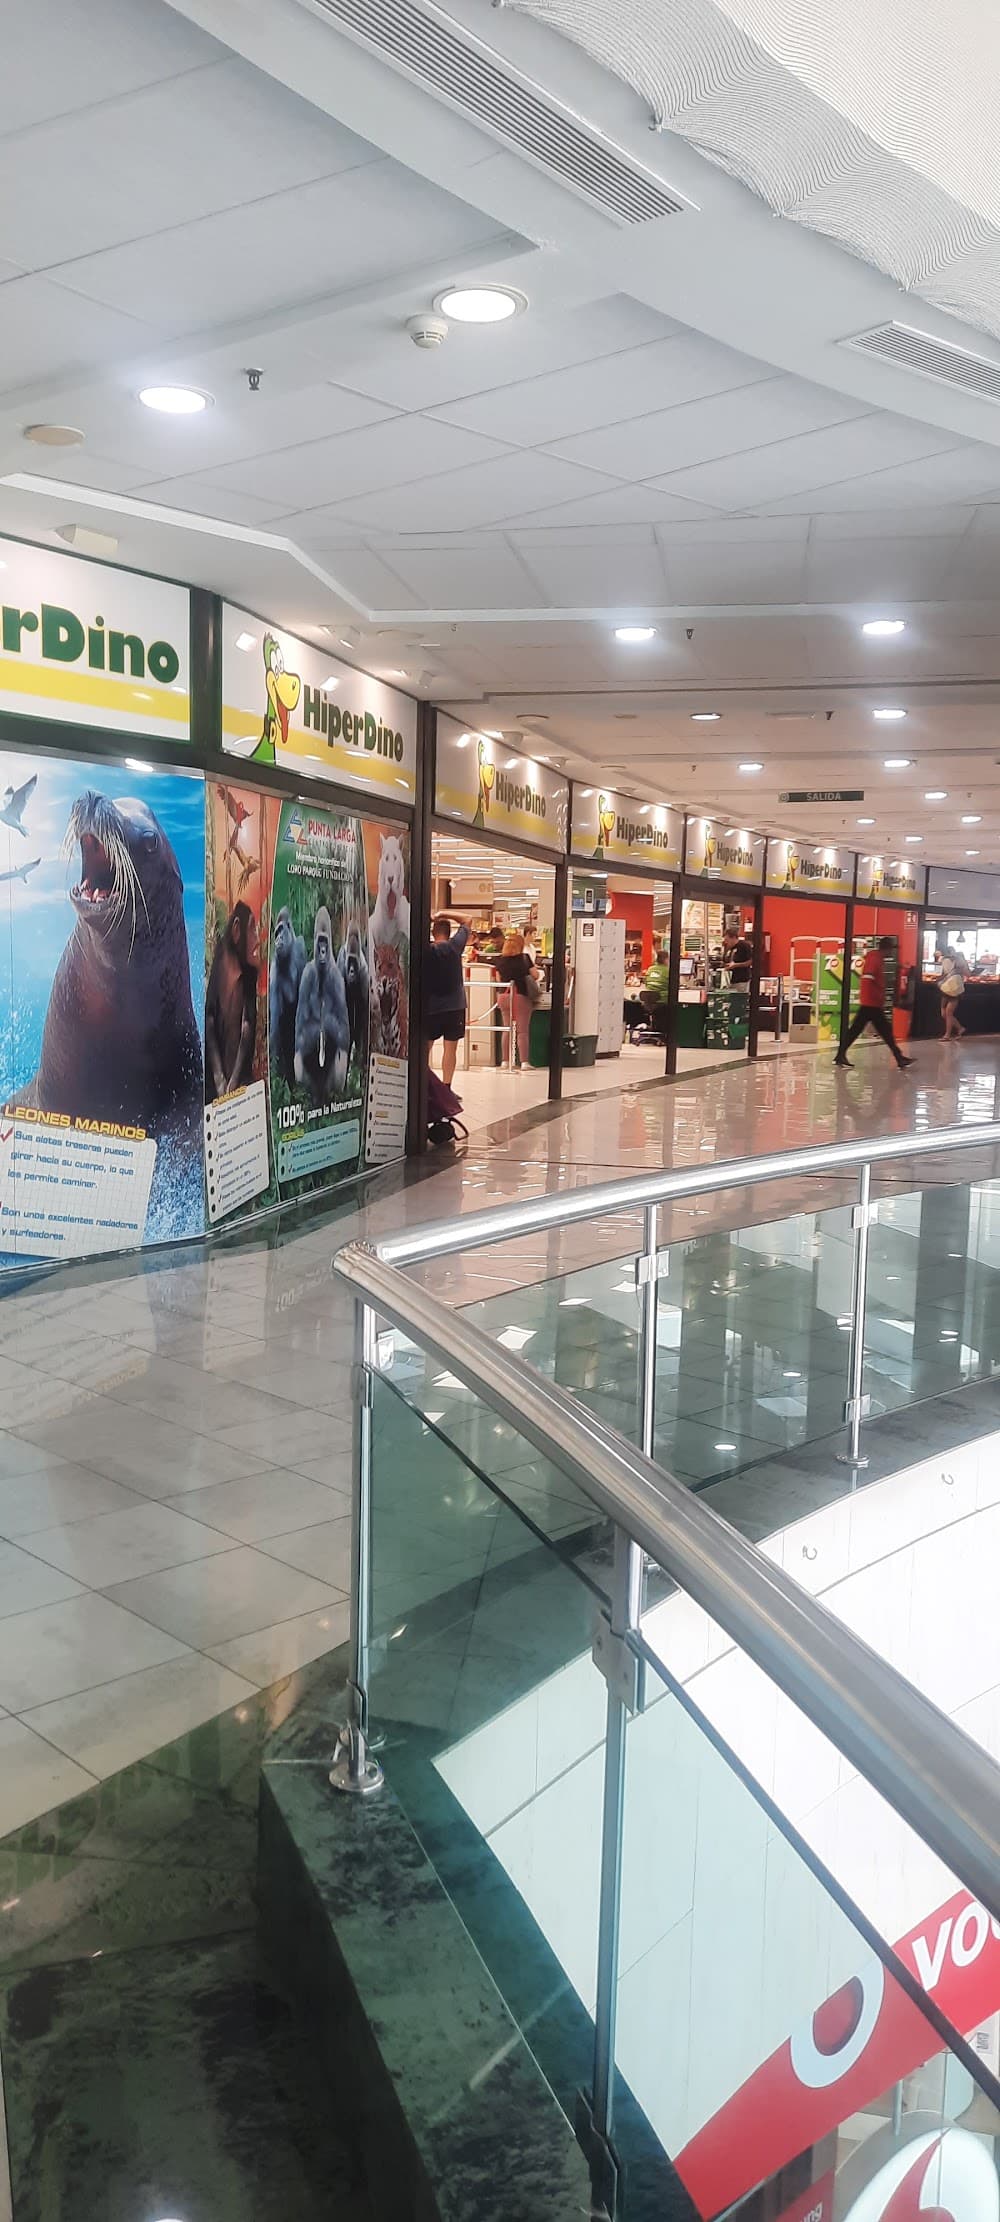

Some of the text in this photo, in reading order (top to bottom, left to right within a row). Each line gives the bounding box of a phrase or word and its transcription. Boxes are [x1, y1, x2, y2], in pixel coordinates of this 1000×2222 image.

[303, 684, 403, 762] HiperDino
[495, 771, 546, 818] HiperDino
[806, 792, 841, 801] SALIDA
[308, 820, 356, 843] PUNTA LARGA
[616, 816, 668, 848] HiperDino
[717, 841, 753, 866] HiperDino
[800, 859, 842, 880] HiperDino
[5, 1104, 147, 1140] LEONES MARINOS
[277, 1103, 305, 1128] 100%
[307, 1108, 322, 1122] para
[323, 1104, 330, 1115] la
[330, 1098, 363, 1113] Naturaleza
[15, 1130, 33, 1142] Sus
[65, 1139, 102, 1152] traseras
[104, 1145, 134, 1158] pueden
[10, 1150, 134, 1177] girar hacia su cuerpo, lo que
[7, 1168, 98, 1189] les permite caminar.
[1, 1207, 138, 1230] Son unos excelentes nadadores
[10, 1229, 66, 1241] surfeadores.
